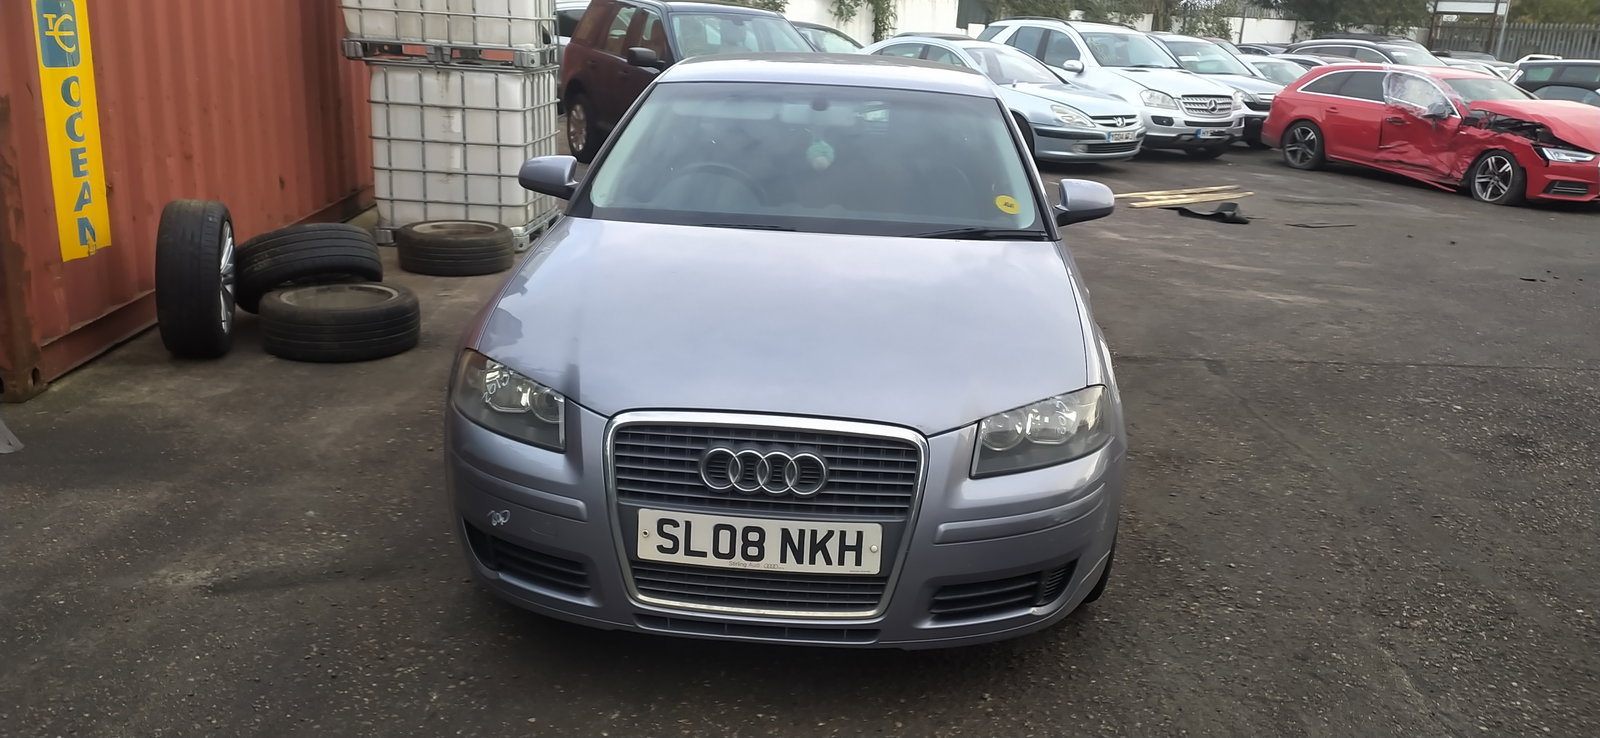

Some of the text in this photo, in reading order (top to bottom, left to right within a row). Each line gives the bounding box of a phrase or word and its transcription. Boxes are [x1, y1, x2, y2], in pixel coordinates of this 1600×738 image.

[61, 75, 97, 246] OCEAN
[656, 517, 864, 567] SL08 NKH
